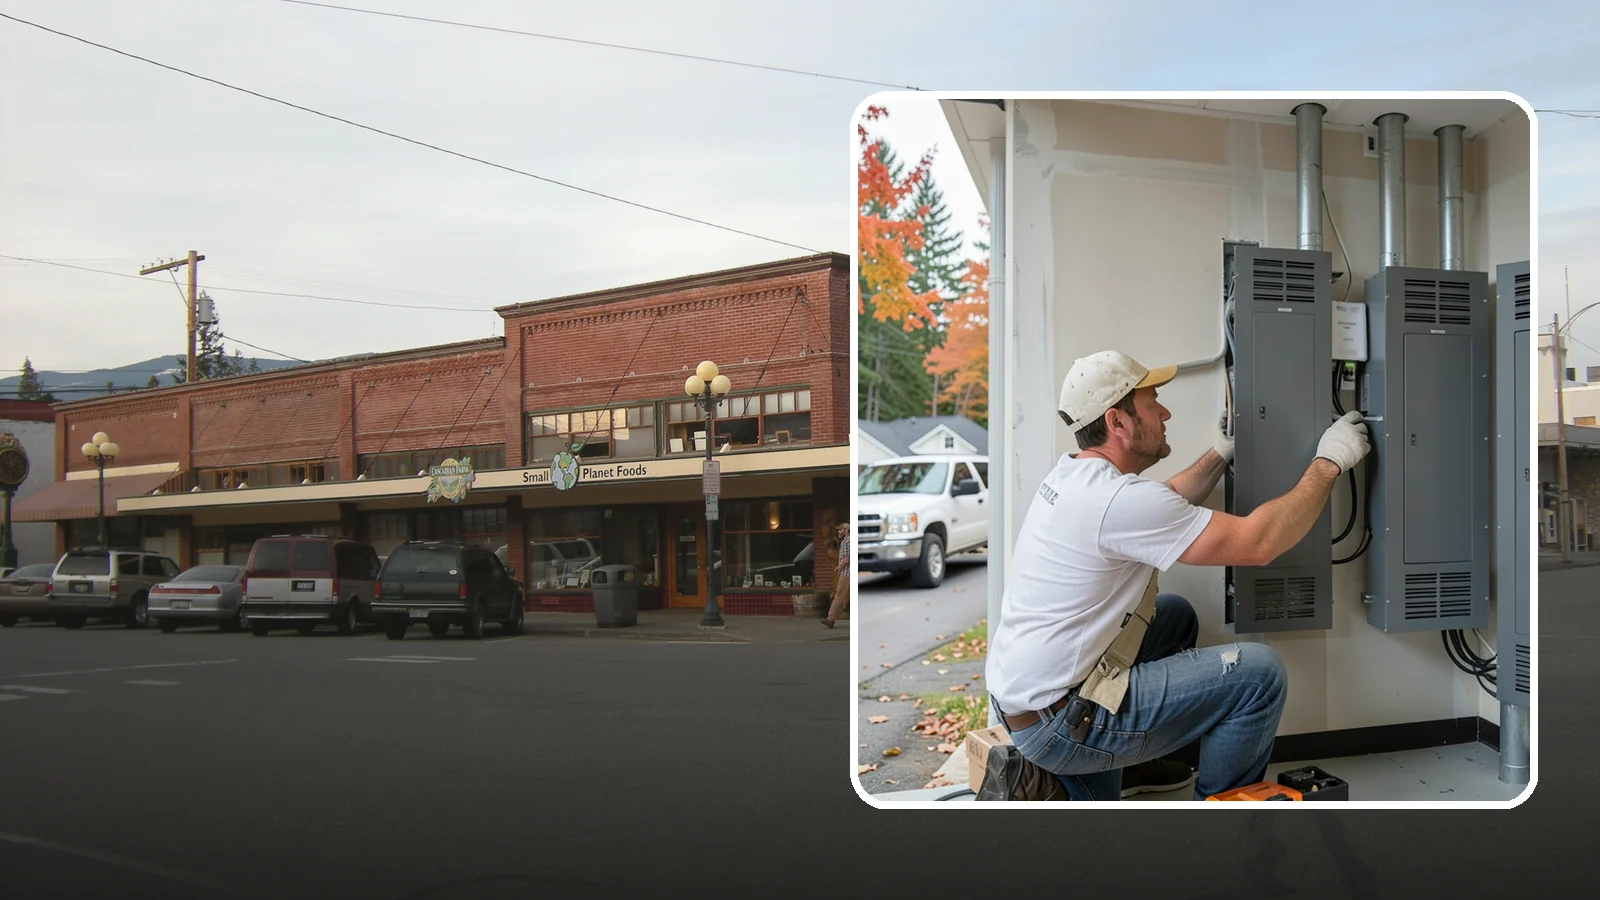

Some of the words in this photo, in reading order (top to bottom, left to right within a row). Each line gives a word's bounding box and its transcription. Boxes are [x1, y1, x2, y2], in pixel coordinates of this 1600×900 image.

[523, 471, 549, 483] Small
[583, 467, 614, 479] Planet
[617, 464, 647, 477] Foods
